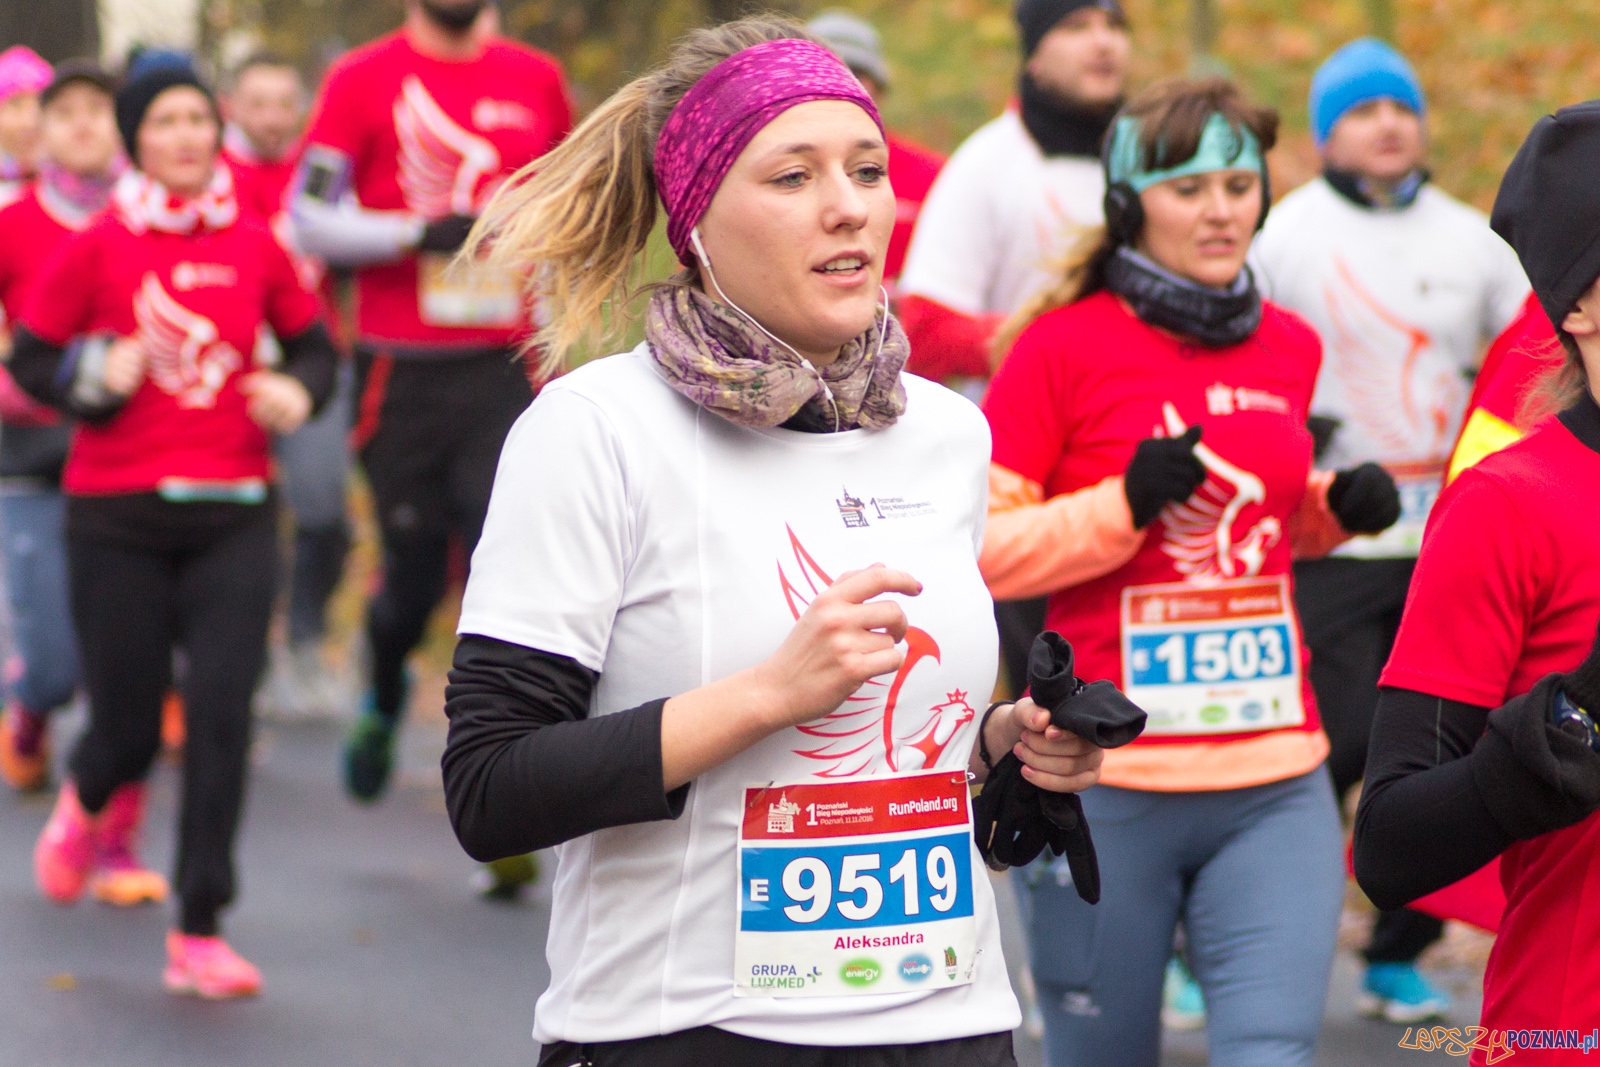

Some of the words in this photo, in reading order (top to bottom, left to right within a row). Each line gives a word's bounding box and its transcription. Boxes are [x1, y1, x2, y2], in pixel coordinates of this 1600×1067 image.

[1155, 626, 1286, 683] 1503
[816, 801, 848, 810] Poznański
[831, 806, 873, 816] Niepodległości
[888, 796, 958, 816] RunPoland.org
[805, 803, 818, 826] 1
[845, 815, 873, 824] 11.11.2016
[750, 878, 769, 902] E
[782, 845, 957, 924] 9519
[834, 932, 924, 950] Aleksandra
[751, 964, 797, 976] GRUPA
[845, 968, 879, 981] energy
